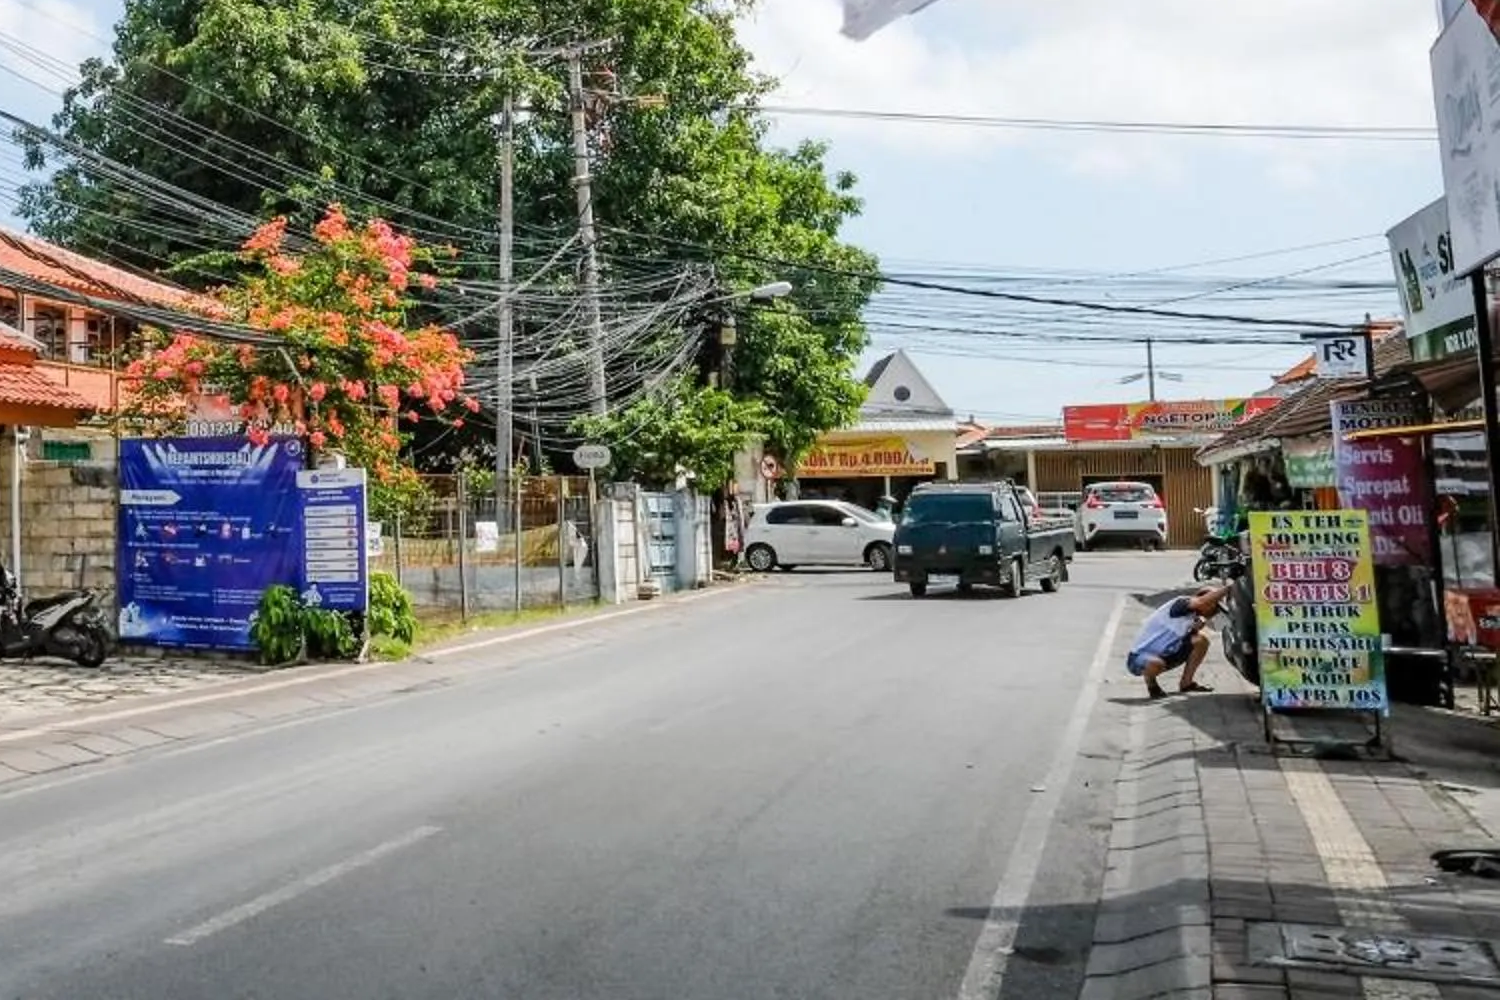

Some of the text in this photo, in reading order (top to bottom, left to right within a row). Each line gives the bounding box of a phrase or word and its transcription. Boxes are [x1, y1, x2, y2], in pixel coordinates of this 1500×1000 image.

[1341, 446, 1393, 465] Servis
[1345, 475, 1411, 499] Sprepat
[1398, 504, 1423, 525] Oli
[1271, 516, 1341, 528] ES TEH
[1264, 533, 1359, 545] TOPPING
[1269, 562, 1327, 580] BELI
[1262, 583, 1350, 601] GRATIS
[1273, 606, 1361, 618] ES JERUK
[1287, 622, 1350, 633] PERAS
[1268, 638, 1377, 650] NUTRISARI
[1281, 656, 1360, 668] POP ICE
[1301, 673, 1352, 685] KOPI
[1276, 688, 1381, 701] EXTRA JOS
